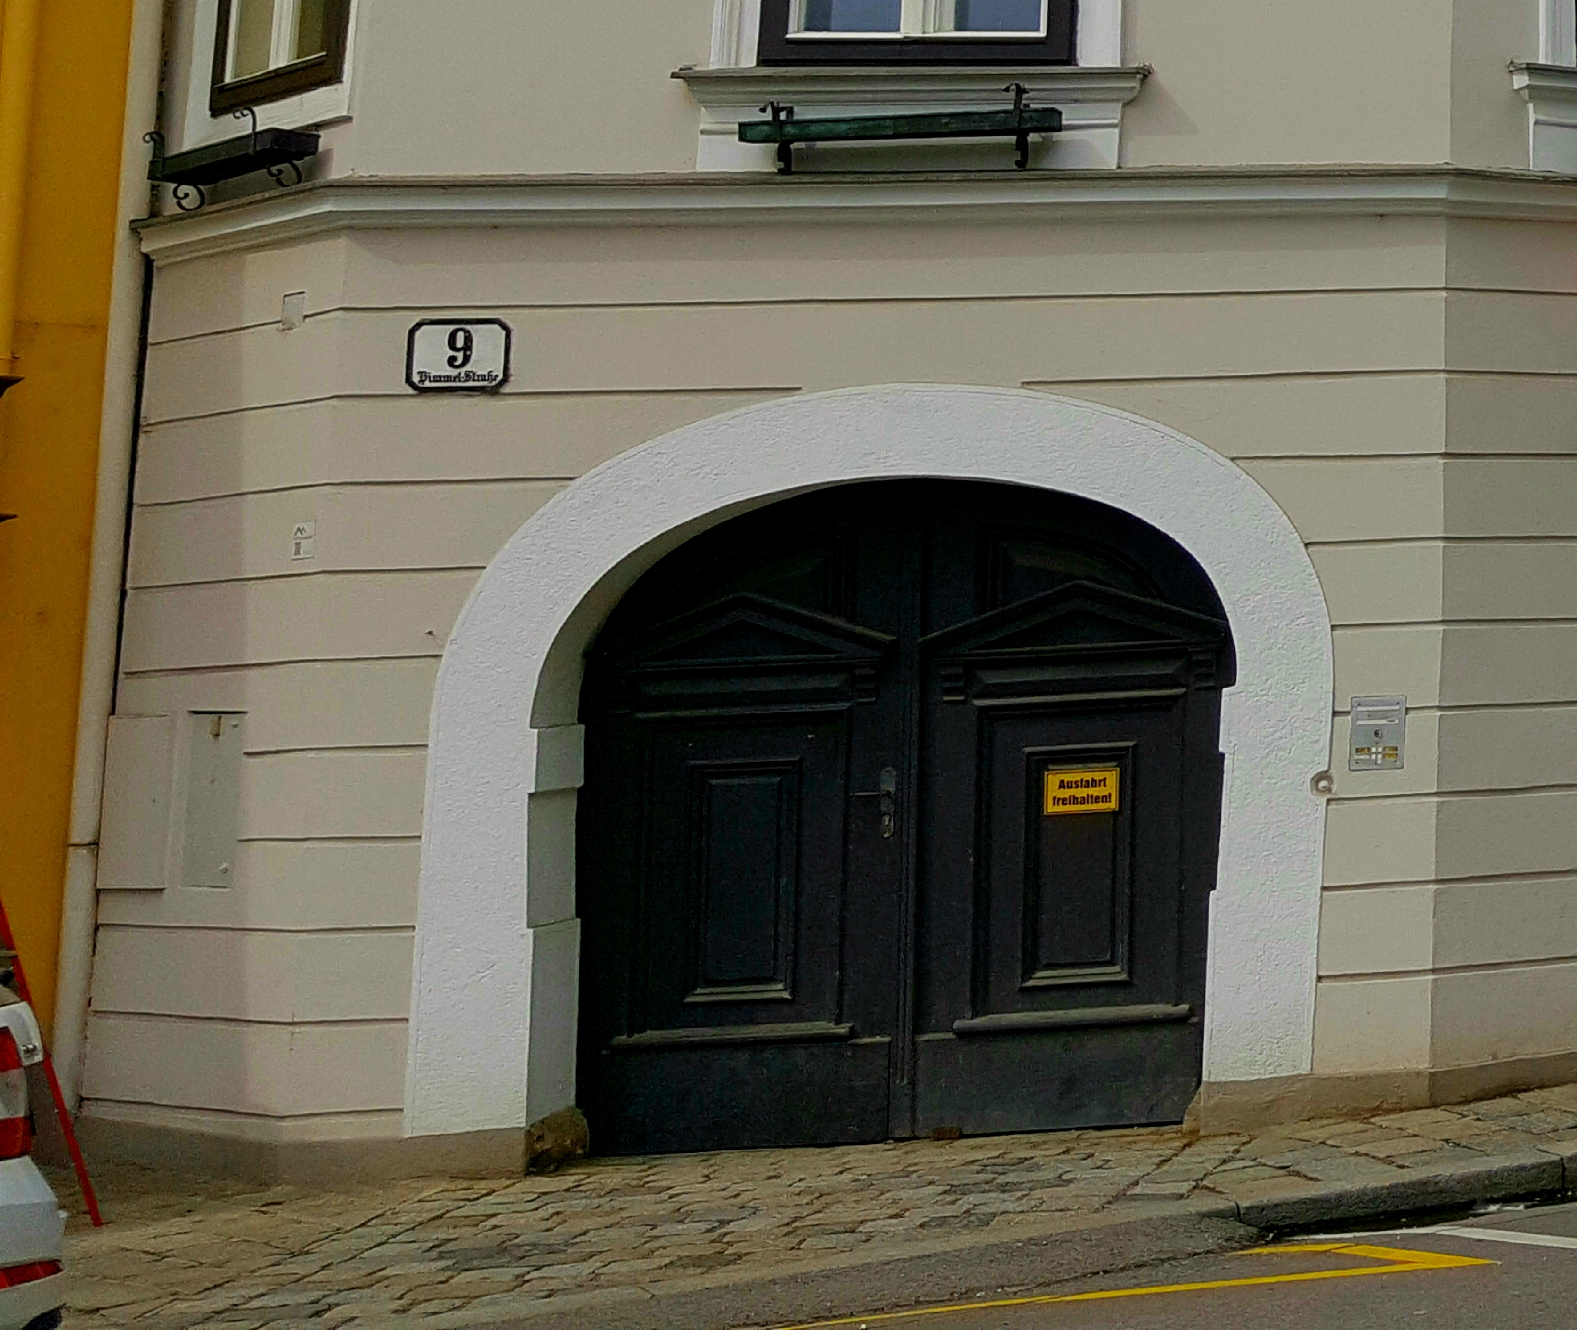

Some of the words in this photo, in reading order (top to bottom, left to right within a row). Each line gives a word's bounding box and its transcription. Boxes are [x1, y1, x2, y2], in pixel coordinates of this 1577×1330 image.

[447, 327, 473, 369] 9
[1058, 777, 1107, 790] Ausfahrt
[1052, 792, 1112, 806] freihalten!
